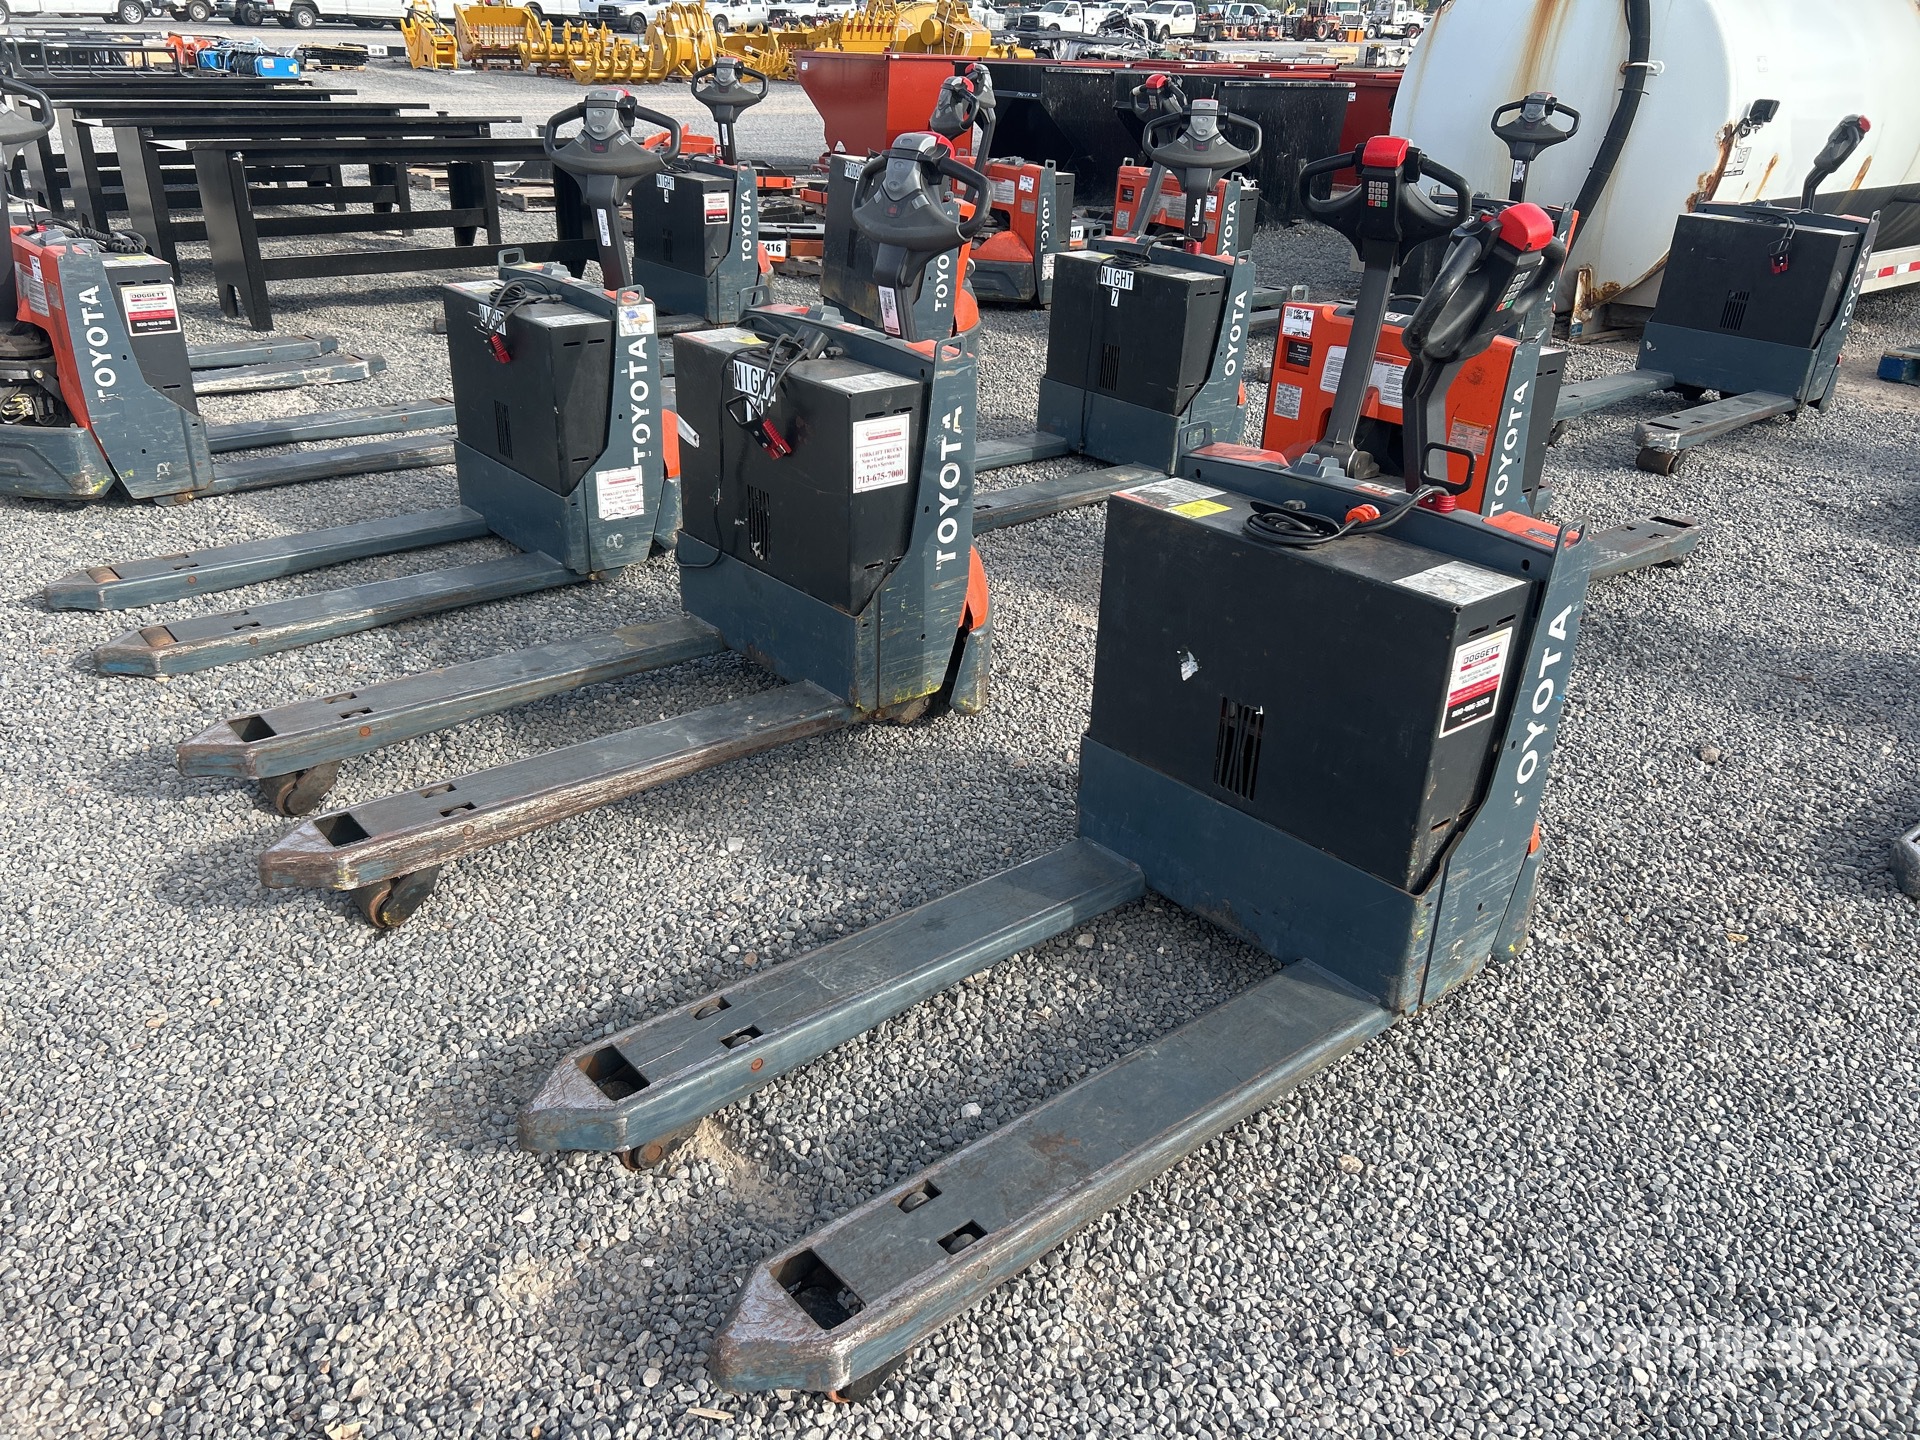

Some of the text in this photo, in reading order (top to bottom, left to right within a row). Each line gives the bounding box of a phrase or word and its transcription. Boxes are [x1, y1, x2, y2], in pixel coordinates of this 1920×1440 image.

[656, 174, 675, 190] NIGHT
[740, 189, 752, 261] TOYOTA
[1101, 266, 1133, 290] NIGHT
[1111, 289, 1119, 306] 7
[1840, 243, 1871, 331] TOYOTA
[78, 285, 119, 404] TOYOTA
[627, 336, 652, 465] TOYOTA
[857, 468, 904, 485] 713-675-7000
[1488, 380, 1530, 519] TOYOTA
[935, 405, 962, 570] TOYOTA
[1463, 645, 1500, 664] DOGGETT
